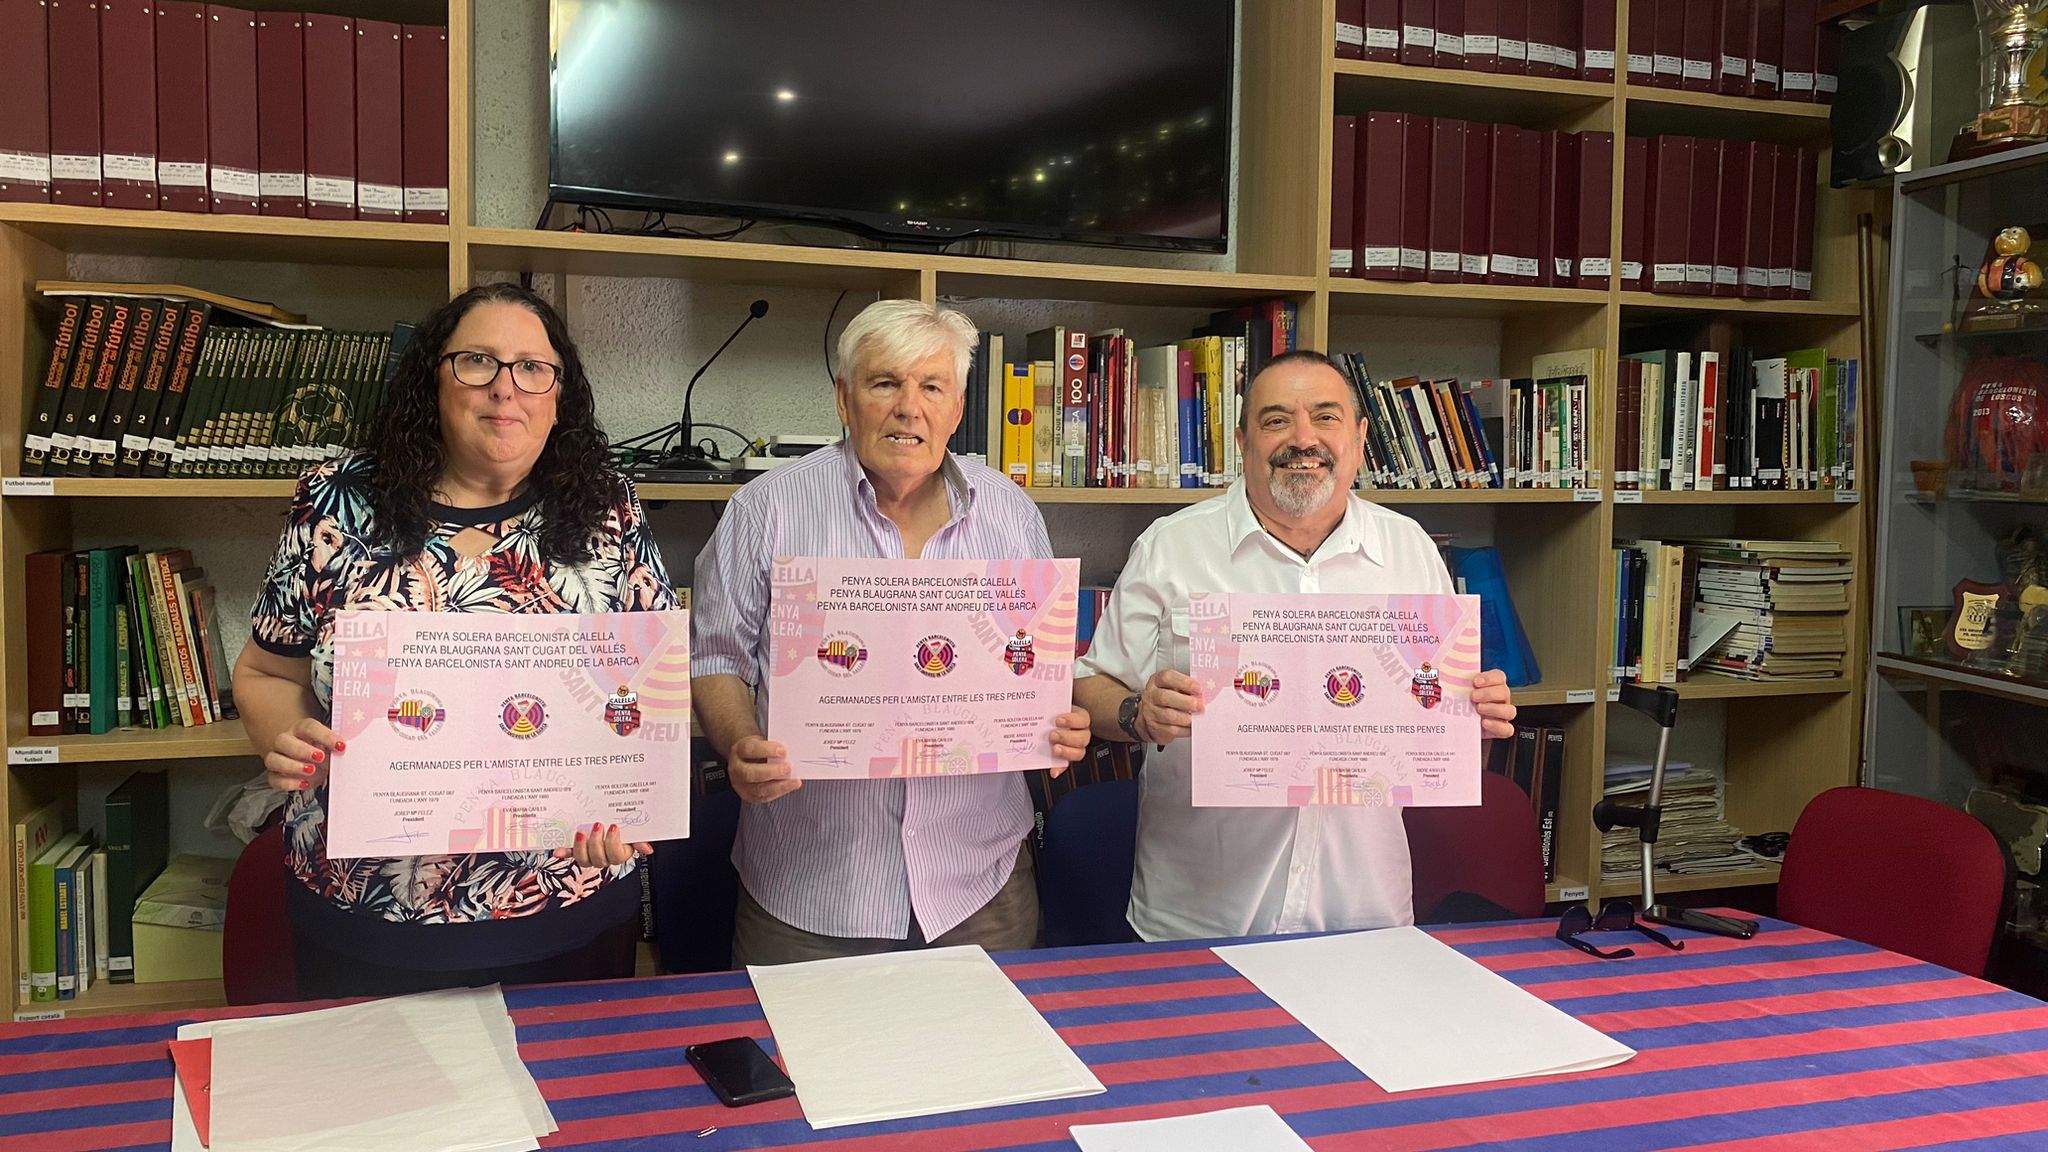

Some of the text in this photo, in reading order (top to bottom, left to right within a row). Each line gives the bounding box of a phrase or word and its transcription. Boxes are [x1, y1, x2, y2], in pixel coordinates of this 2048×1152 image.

[1072, 378, 1083, 405] 100
[1972, 407, 1990, 416] 2013
[40, 413, 48, 422] 6
[66, 414, 73, 422] 5
[88, 414, 96, 423] 4
[113, 415, 121, 423] 3
[138, 415, 145, 424] 2
[164, 417, 169, 425] 1
[842, 576, 1016, 587] PENYA SOLERA BARCELONISTA CALELLA
[167, 590, 176, 600] DE
[830, 588, 1025, 600] PENYA BLAUGRANA SANT CUGAT DEL VALLÉS
[817, 601, 1036, 612] PENYA BARCELONISTA SANT ANDREU DE LA BARCA
[1253, 610, 1418, 620] PENYA SOLERA BARCELONISTA CALELLA
[168, 602, 185, 646] MUNDIALES
[1242, 622, 1428, 632] PENYA BLAUGRANA SANT CUGAT DEL VALLÉS
[336, 622, 384, 638] ELLA
[416, 631, 614, 642] PENYA SOLERA BARCELONISTA CALELLA
[1231, 634, 1440, 644] PENYA BARCELONISTA SANT ANDREU DE LA BARCA
[403, 643, 626, 655] PENYA BLAUGRANA SANT CUGAT DEL VALLÉS
[388, 657, 639, 669] PENYA BARCELONISTA SANT ANDREU DE LA BARCA
[819, 691, 1036, 704] AGERMANADES PER L'AMISTAT ENTRE LES TRES PENYES
[1237, 725, 1295, 733] AGERMANADES
[1314, 725, 1351, 733] L'AMISTAT
[390, 754, 644, 770] AGERMANADES PER L'AMISTAT ENTRE LES TRES PENYES
[705, 770, 725, 782] PENYES
[1542, 818, 1552, 829] Est
